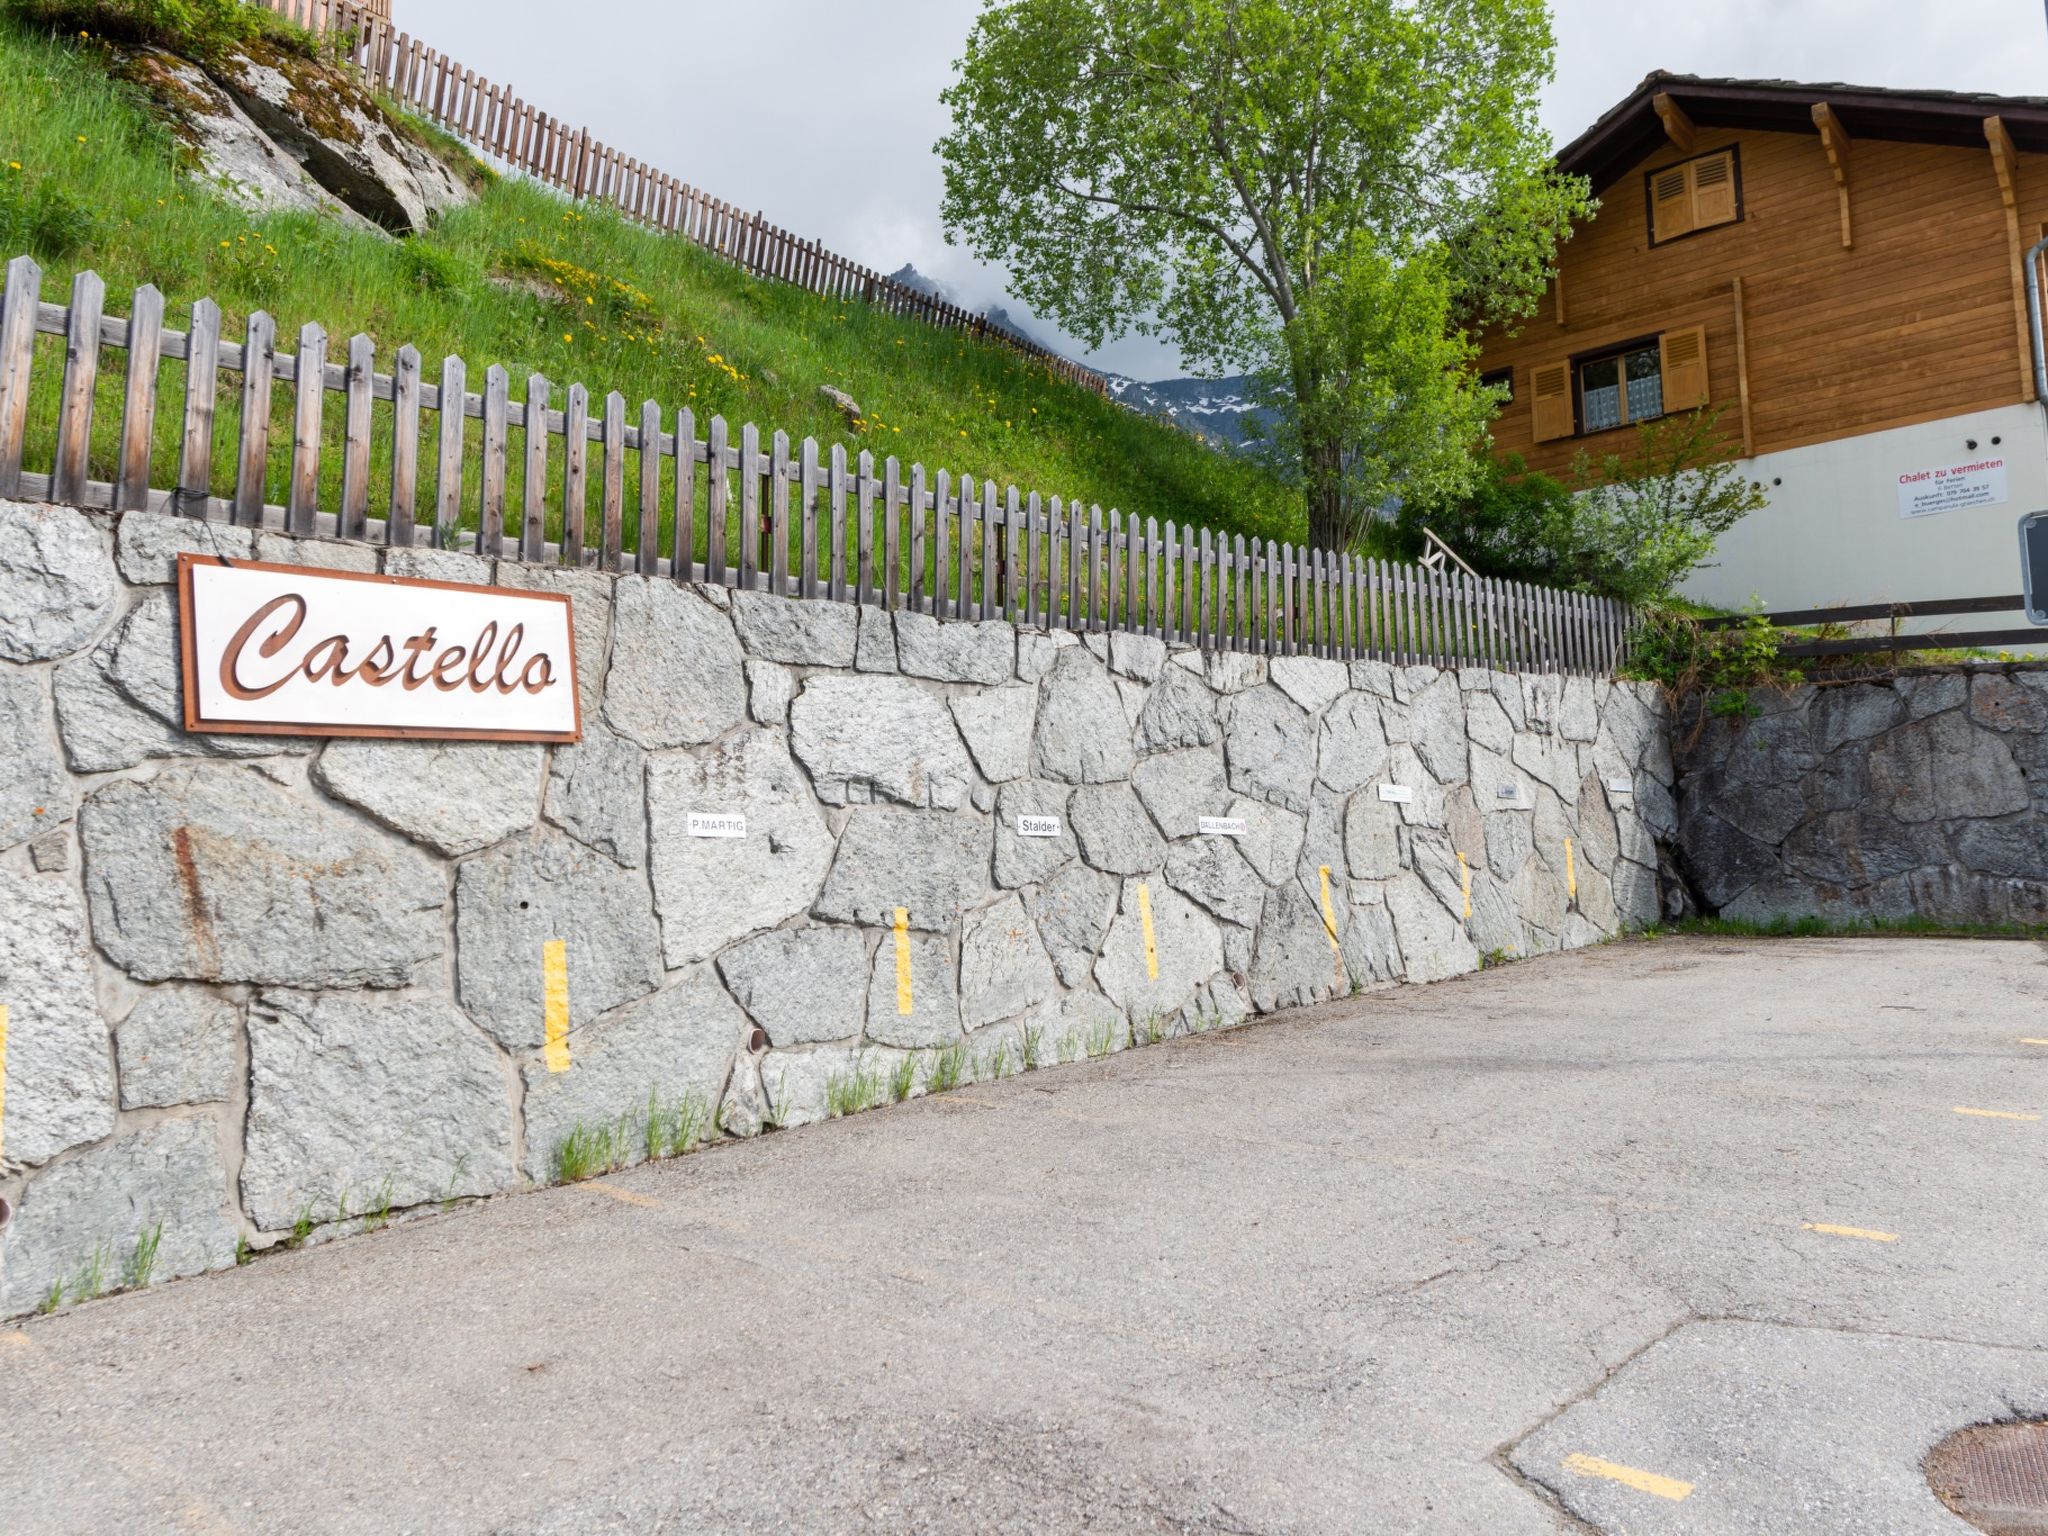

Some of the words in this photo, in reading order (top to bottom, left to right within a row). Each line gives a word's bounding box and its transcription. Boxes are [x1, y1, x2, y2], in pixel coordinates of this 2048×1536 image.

[1899, 471, 1931, 484] Chalet
[1935, 469, 1947, 478] zu
[1951, 459, 2003, 475] vermieten
[219, 593, 557, 702] Castello
[1022, 819, 1056, 831] Stalder
